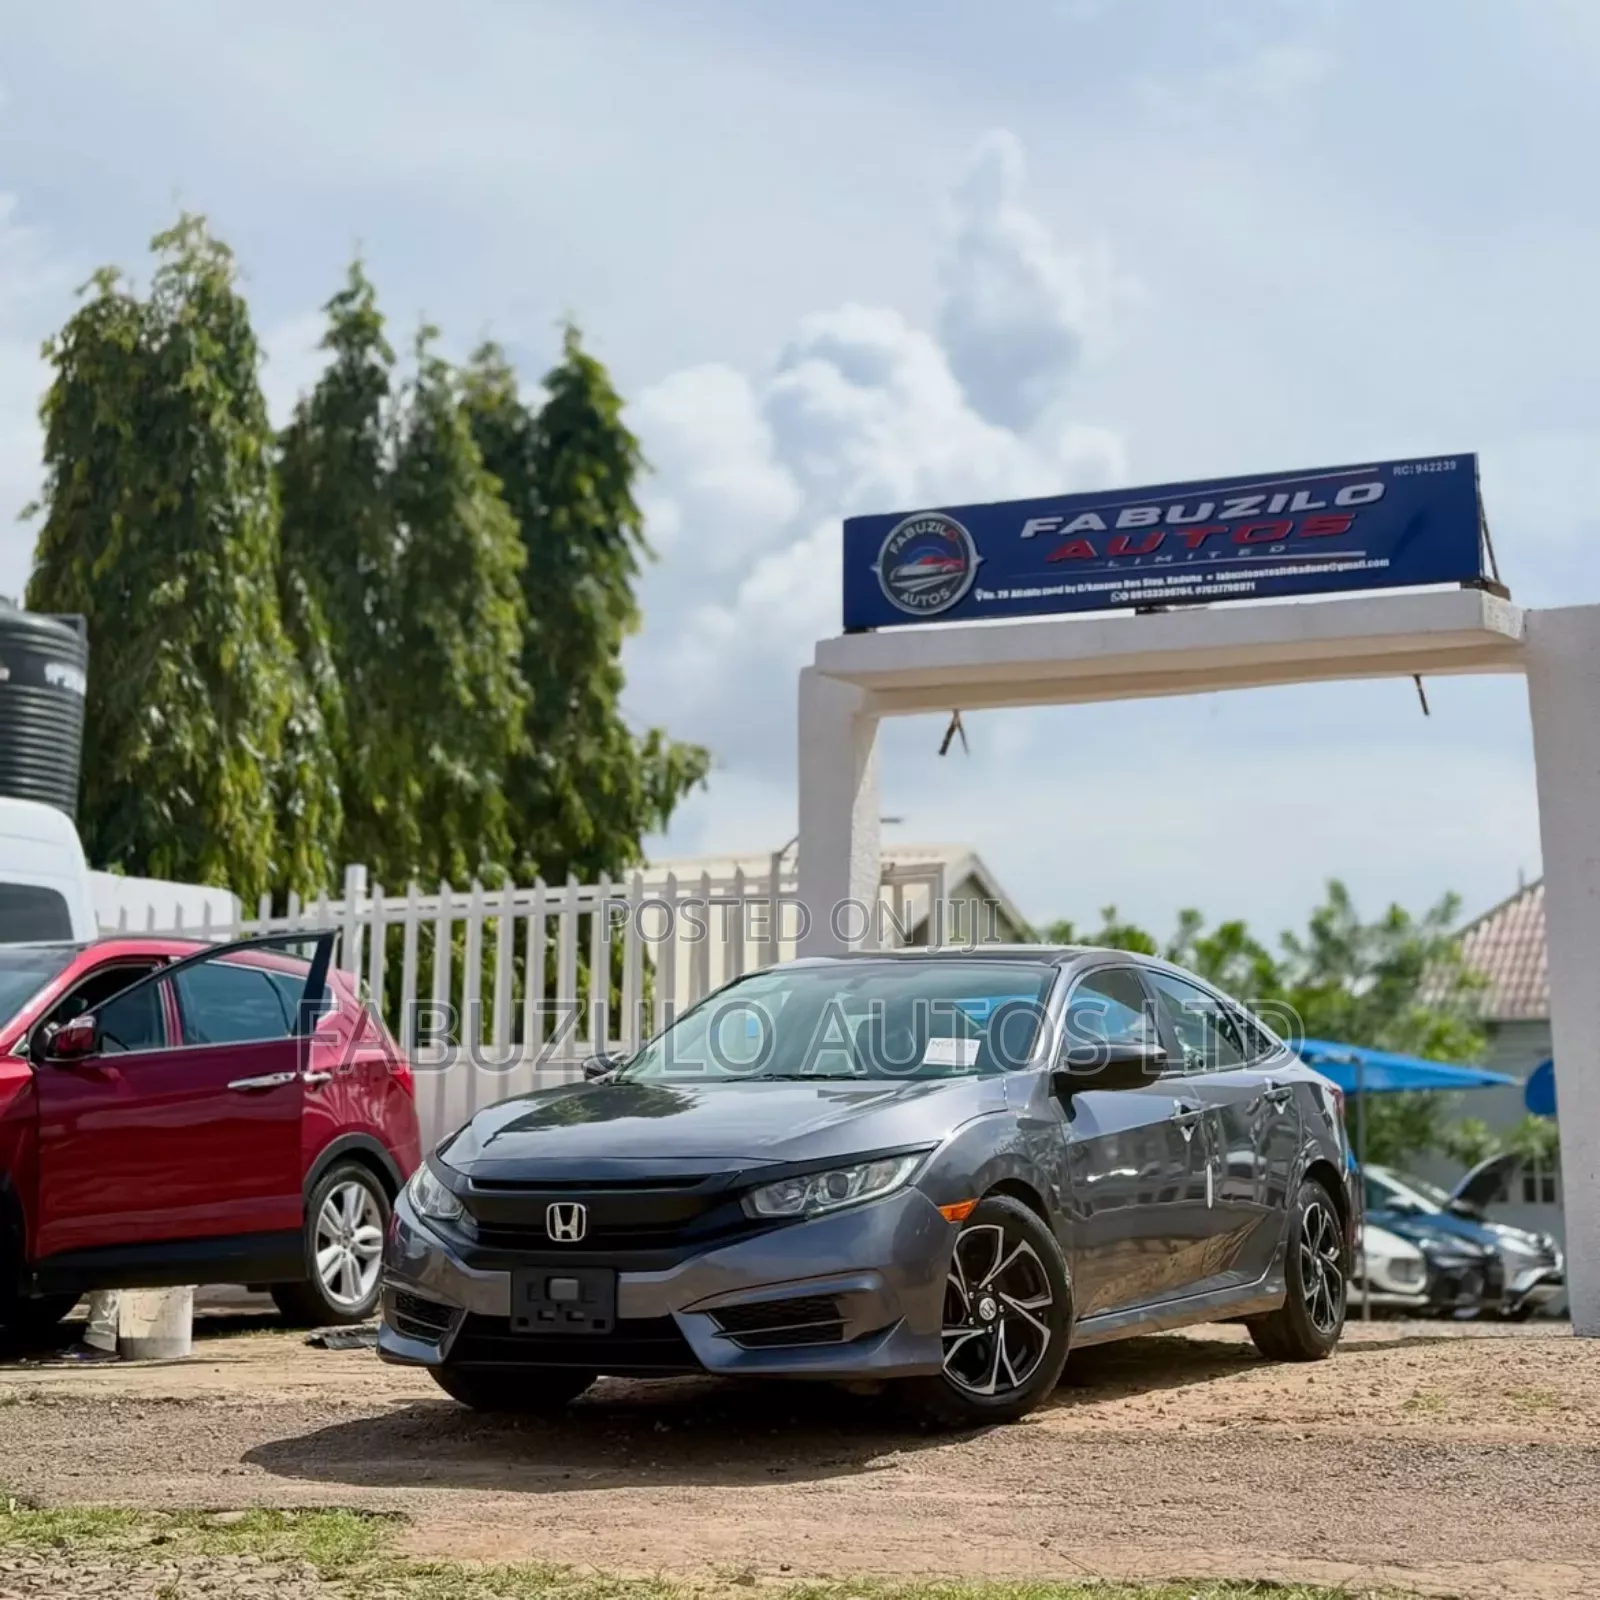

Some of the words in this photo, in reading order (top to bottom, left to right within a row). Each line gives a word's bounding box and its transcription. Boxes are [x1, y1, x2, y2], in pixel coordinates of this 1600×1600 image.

[1020, 481, 1386, 539] FABUZILO
[889, 520, 959, 555] FABUZILO
[1045, 512, 1356, 563] AUTOS
[899, 587, 952, 607] AUTOS
